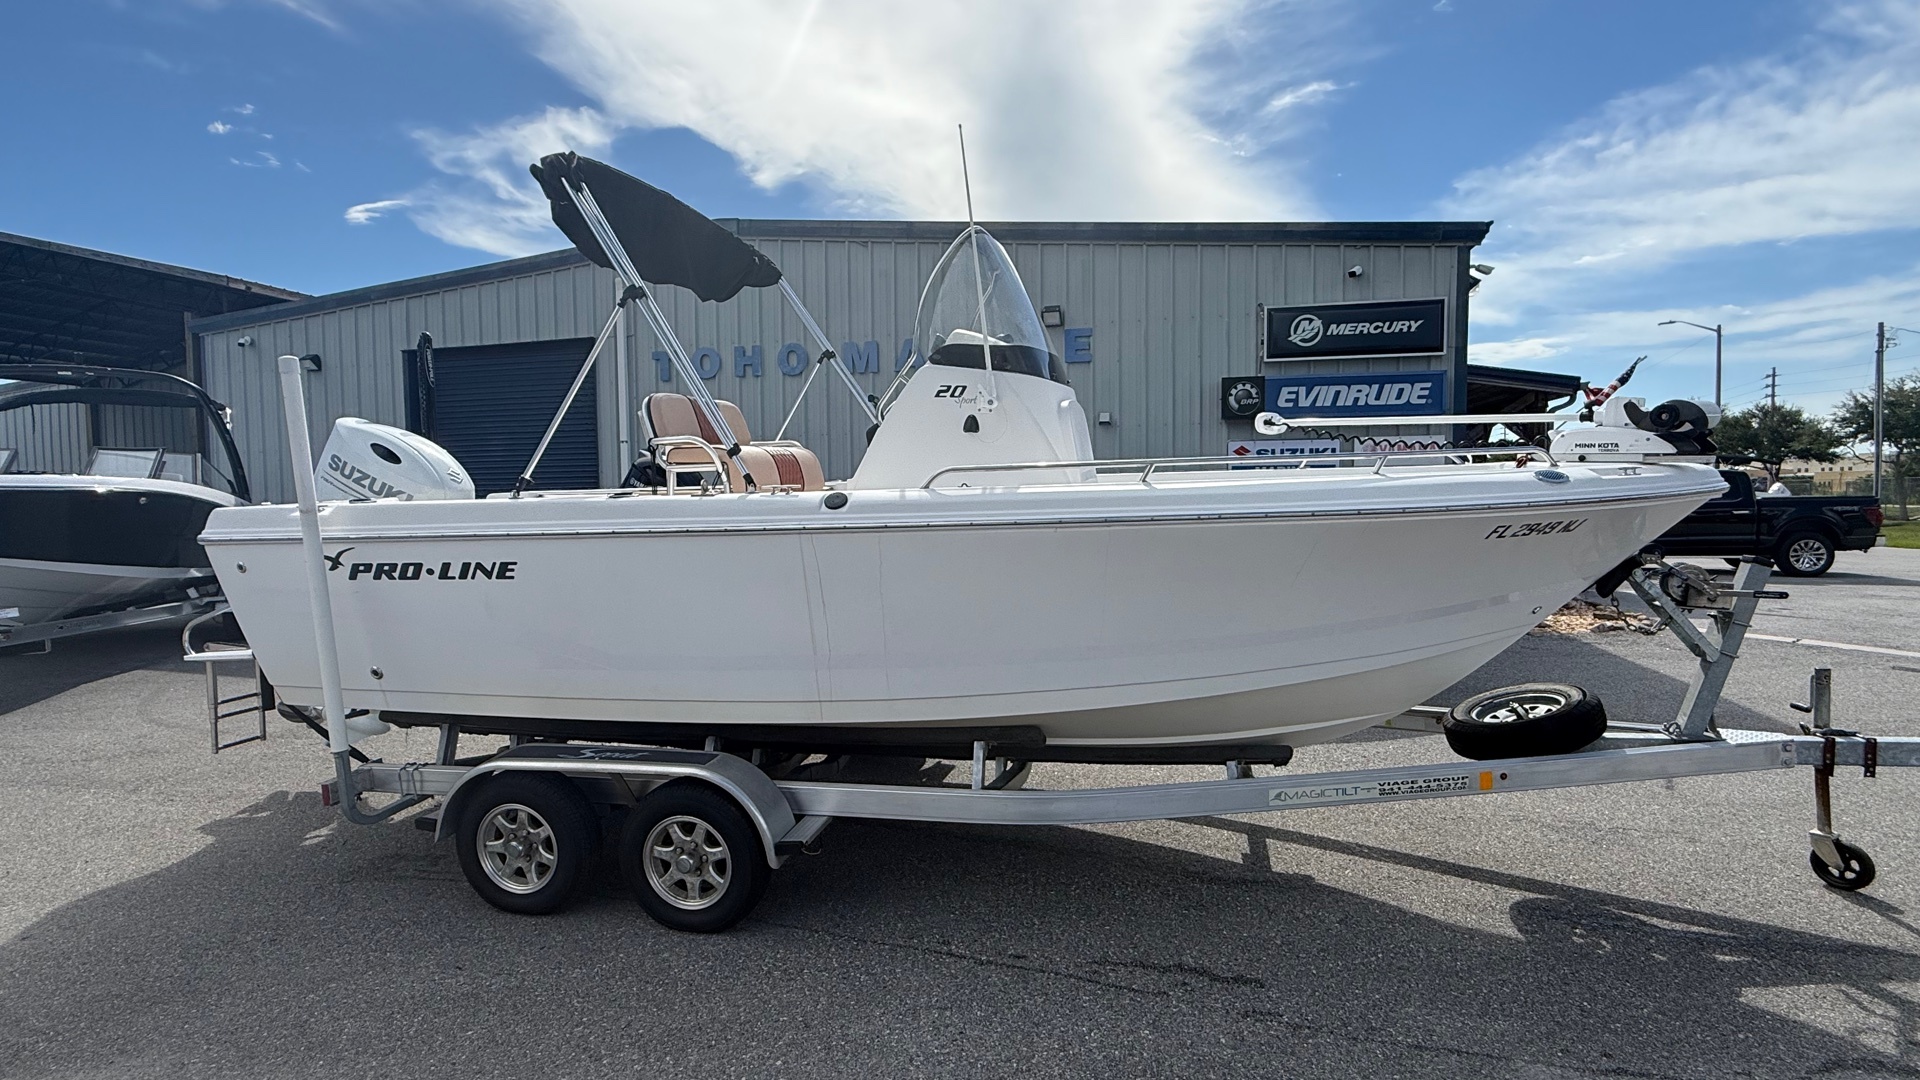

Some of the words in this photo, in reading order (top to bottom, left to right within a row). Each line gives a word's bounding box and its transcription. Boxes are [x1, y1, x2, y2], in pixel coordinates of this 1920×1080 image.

[1326, 320, 1424, 335] MERCURY
[652, 343, 809, 382] TOHO
[842, 328, 1093, 373] MAE
[934, 385, 967, 398] 20
[1277, 382, 1432, 408] EVINRUDE
[954, 395, 978, 409] Sport
[1484, 524, 1512, 539] FL
[1509, 521, 1564, 538] 2949
[1377, 779, 1419, 787] VIAGE
[1422, 775, 1469, 784] GROUP
[1284, 786, 1361, 801] MAGICTILT
